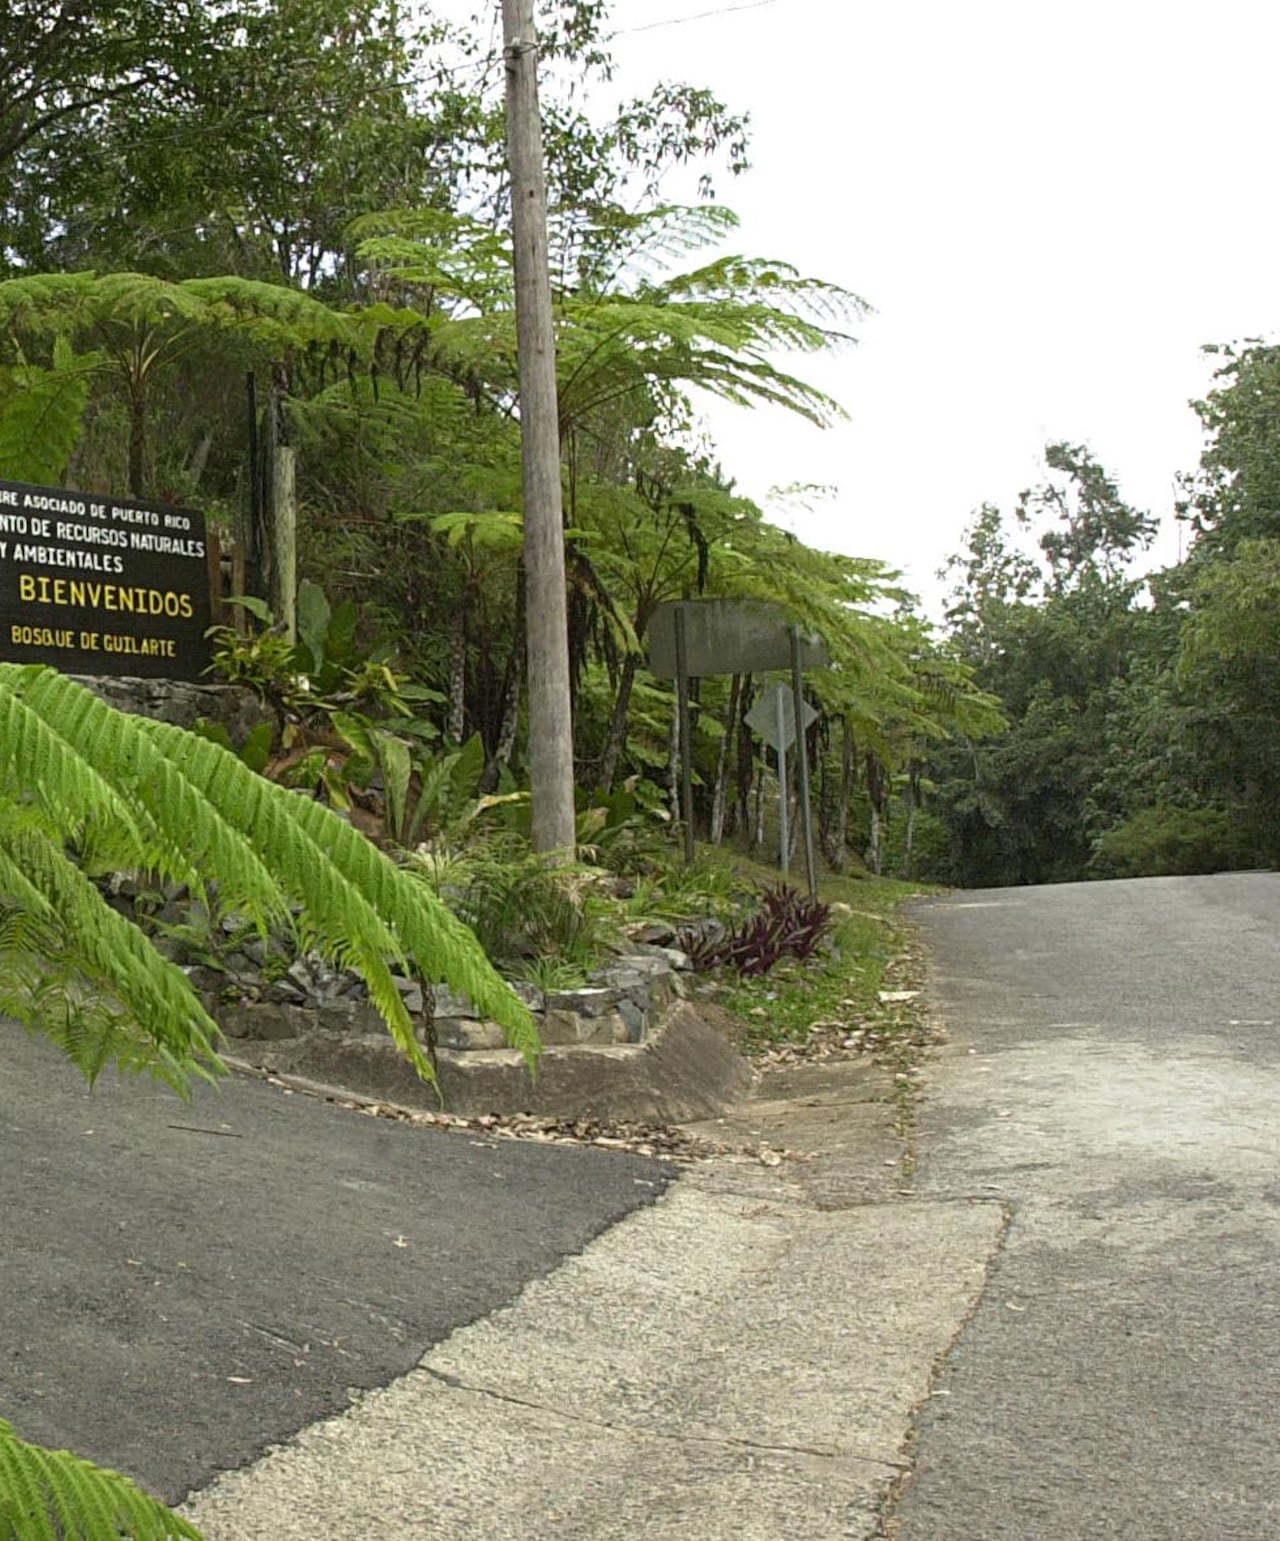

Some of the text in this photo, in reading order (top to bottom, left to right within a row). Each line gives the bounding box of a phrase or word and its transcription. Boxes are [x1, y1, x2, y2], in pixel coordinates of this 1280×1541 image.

[23, 494, 86, 516] ASOCIADO
[90, 504, 107, 520] DE
[111, 506, 160, 526] PUERTO
[164, 514, 191, 530] RICO
[31, 519, 51, 537] DE
[56, 521, 128, 548] RECURSOS
[130, 534, 205, 558] NATURALES
[13, 543, 124, 573] AMBIENTALES
[19, 574, 193, 618] BIENVENIDOS
[11, 625, 176, 657] BOSQUE DE GUILARTE
